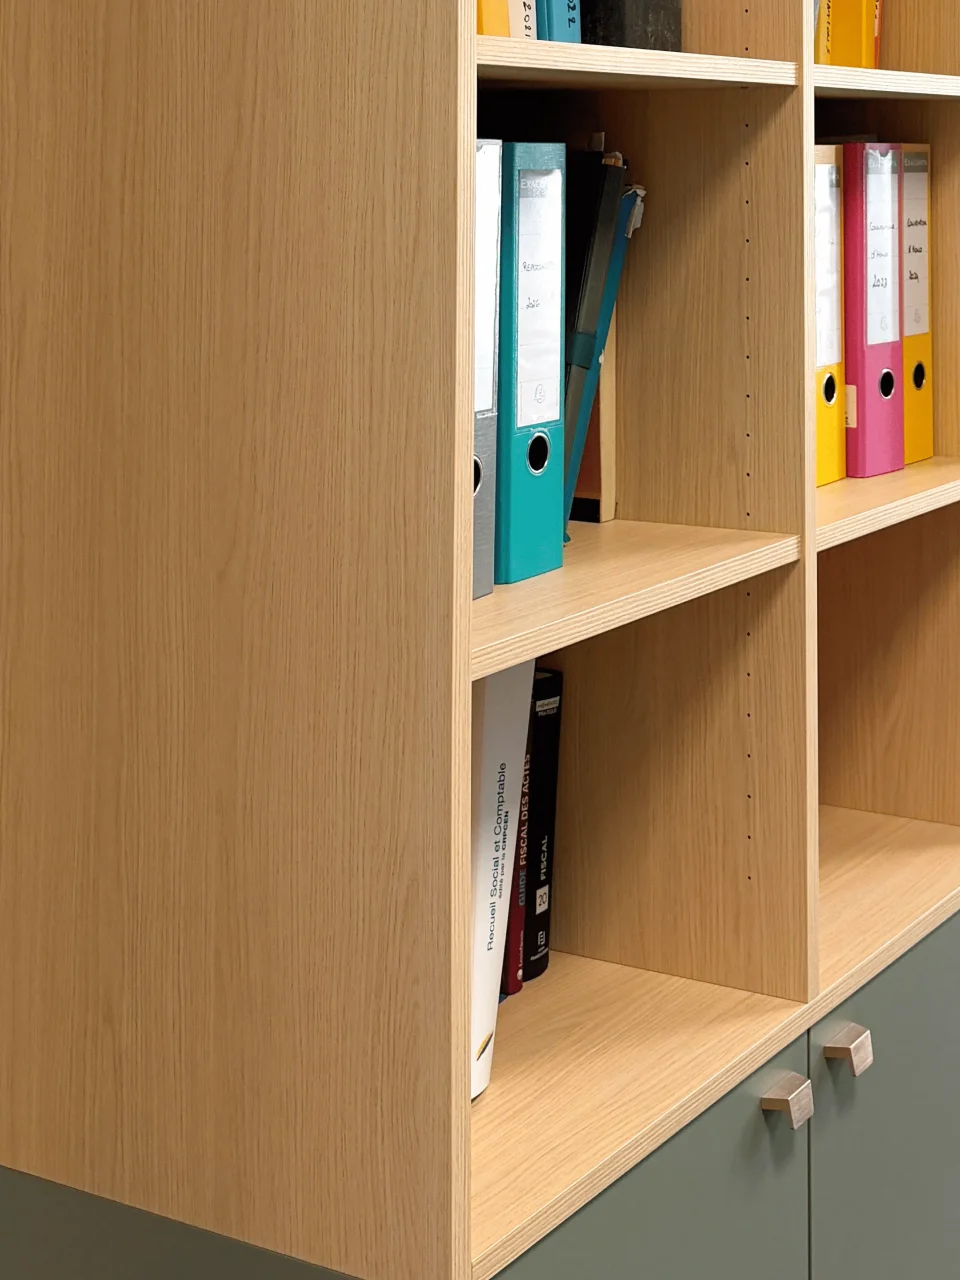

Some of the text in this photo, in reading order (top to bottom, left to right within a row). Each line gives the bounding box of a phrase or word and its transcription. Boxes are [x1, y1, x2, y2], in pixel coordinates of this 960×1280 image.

[522, 0, 532, 38] 2021
[522, 754, 530, 793] ACTES
[521, 796, 529, 820] DES
[487, 762, 507, 951] Recueil Social et Comptable
[520, 822, 528, 866] FISCAL
[540, 835, 548, 881] FISCAL
